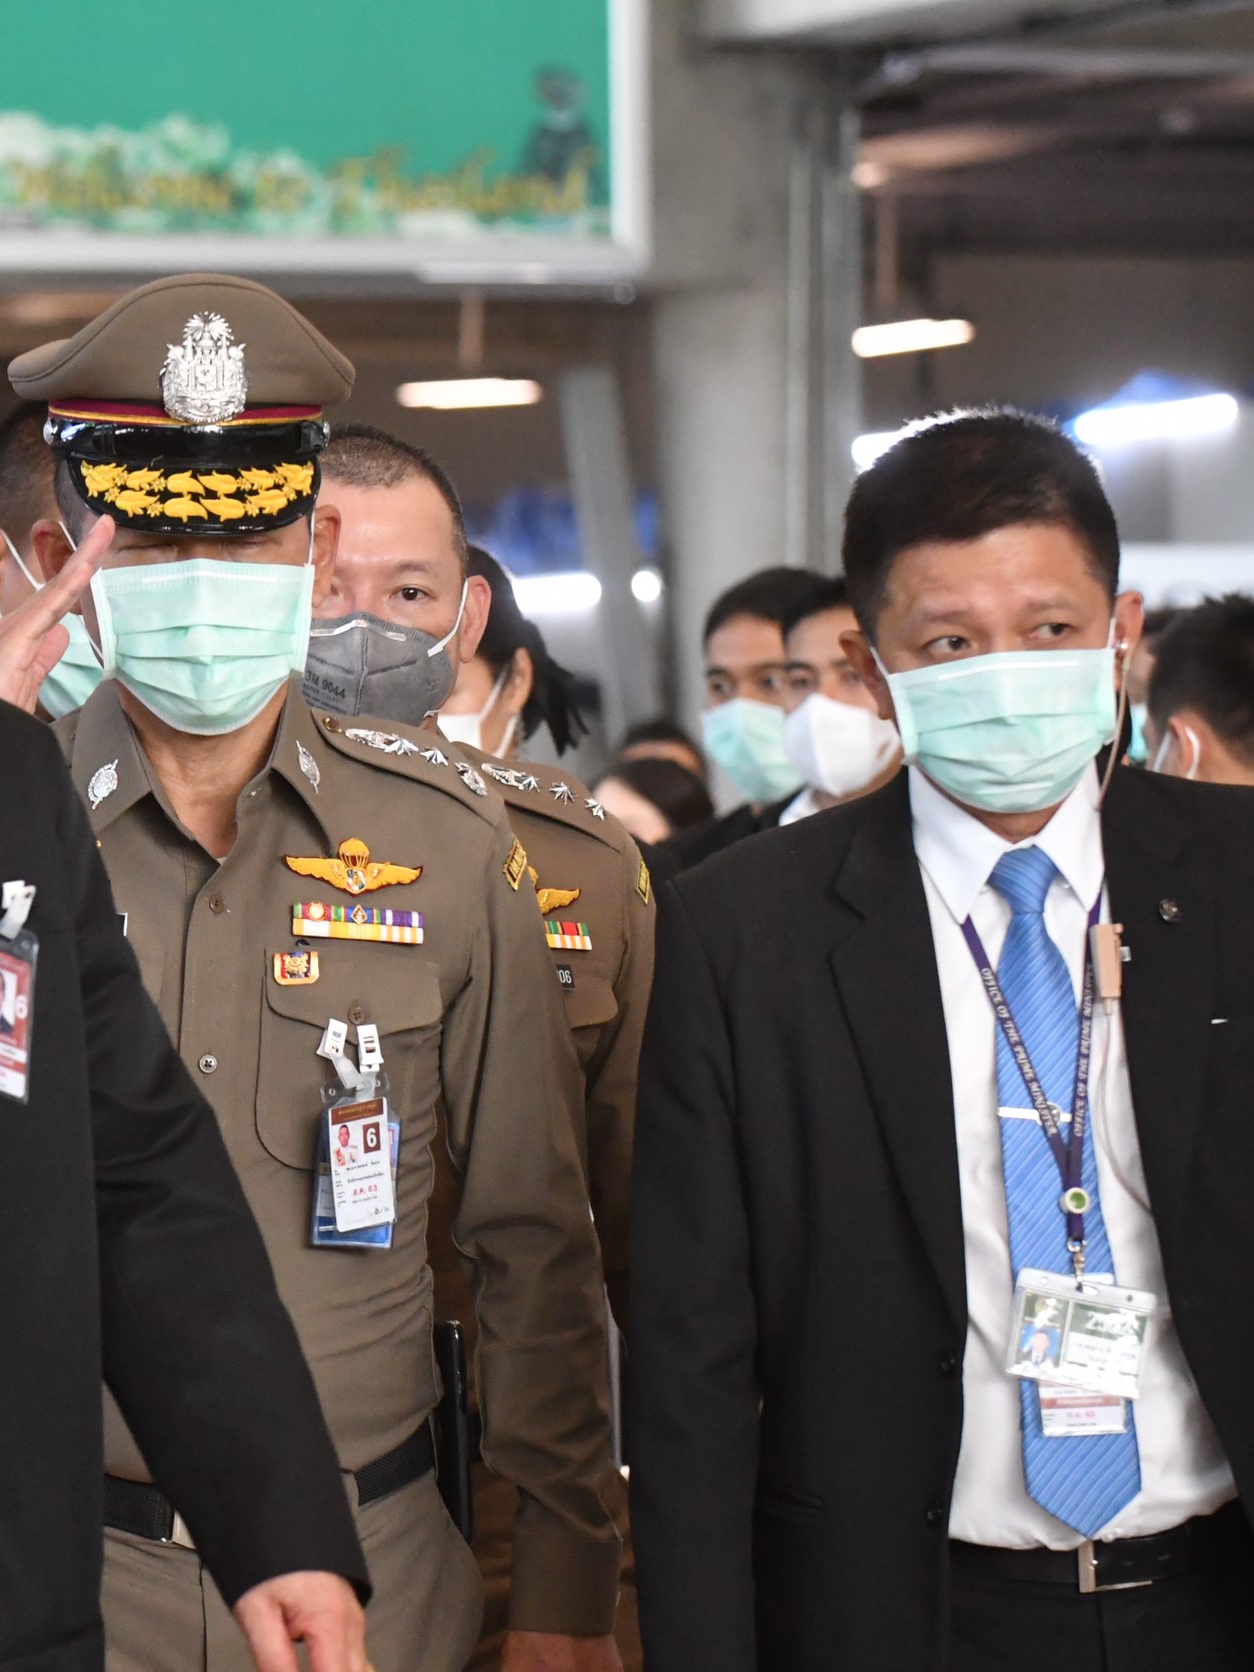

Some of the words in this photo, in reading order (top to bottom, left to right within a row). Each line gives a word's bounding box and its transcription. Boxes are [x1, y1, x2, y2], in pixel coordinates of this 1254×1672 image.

[305, 670, 320, 686] 3M
[322, 679, 346, 699] 9044
[556, 969, 572, 984] 06
[15, 994, 28, 1020] 6
[981, 967, 1003, 1004] OFFICE
[996, 1005, 1010, 1018] OF
[1004, 1020, 1020, 1044] THE
[1013, 1045, 1035, 1081] PRIME
[1080, 1018, 1091, 1054] PRIME
[1078, 1057, 1089, 1080] THE
[1077, 1081, 1087, 1097] OF
[1074, 1098, 1085, 1137] OFFICE
[366, 1127, 377, 1148] 6
[368, 1184, 378, 1193] 63
